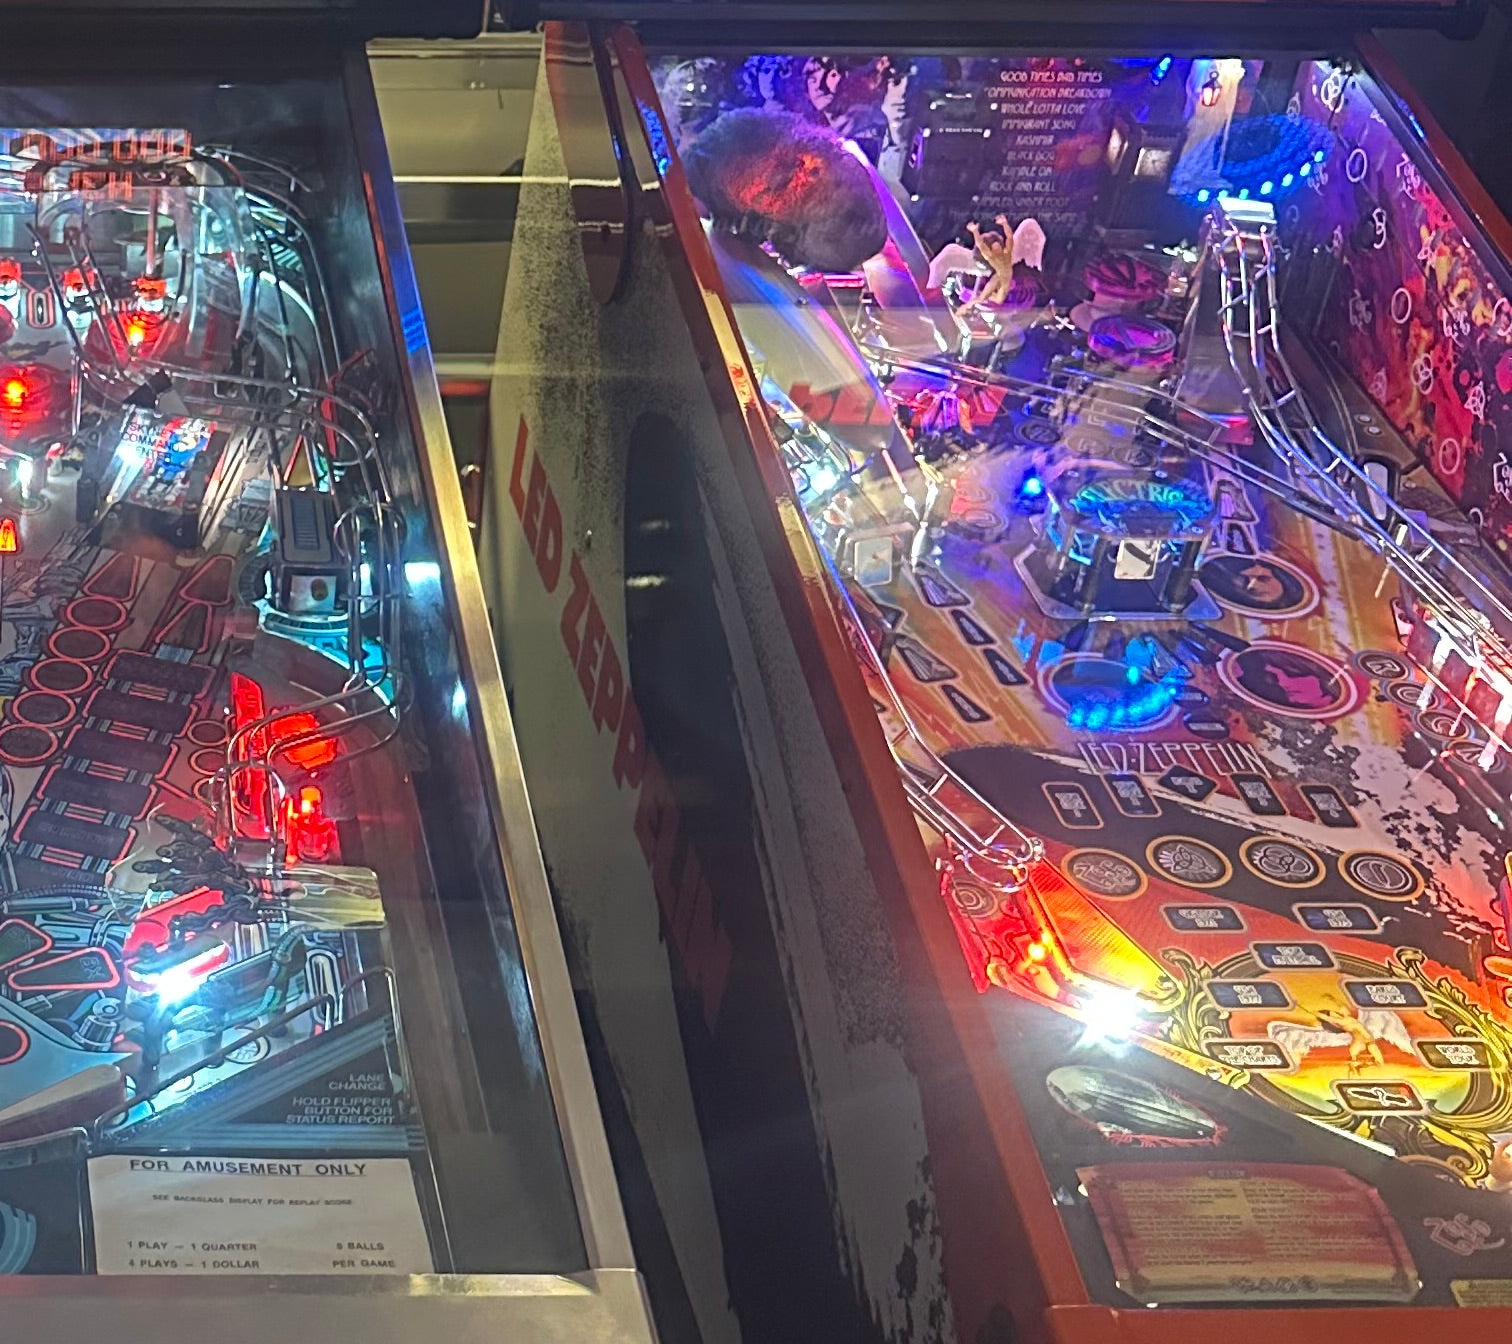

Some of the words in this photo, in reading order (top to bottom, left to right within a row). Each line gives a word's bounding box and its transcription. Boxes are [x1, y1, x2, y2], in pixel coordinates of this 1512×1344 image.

[1000, 70, 1028, 83] GOOD
[508, 413, 568, 598] LED
[349, 1073, 385, 1082] LANE
[328, 1081, 386, 1091] CHANGE
[292, 1096, 330, 1106] HOLD
[333, 1097, 391, 1106] FLIPPER
[304, 1106, 361, 1115] BUTTON
[363, 1106, 393, 1116] FOR
[286, 1115, 336, 1124] STATUS
[337, 1115, 395, 1125] REPORT
[129, 1159, 170, 1171] FOR
[182, 1160, 303, 1176] AMUSEMENT
[315, 1164, 368, 1176] ONLY
[138, 1241, 168, 1251] PLAY
[201, 1242, 258, 1252] QUARTER
[347, 1242, 386, 1252] BALLS
[140, 1259, 179, 1269] PLAYS
[212, 1260, 261, 1270] DOLLAR
[332, 1259, 356, 1269] PER
[360, 1259, 397, 1269] GAME
